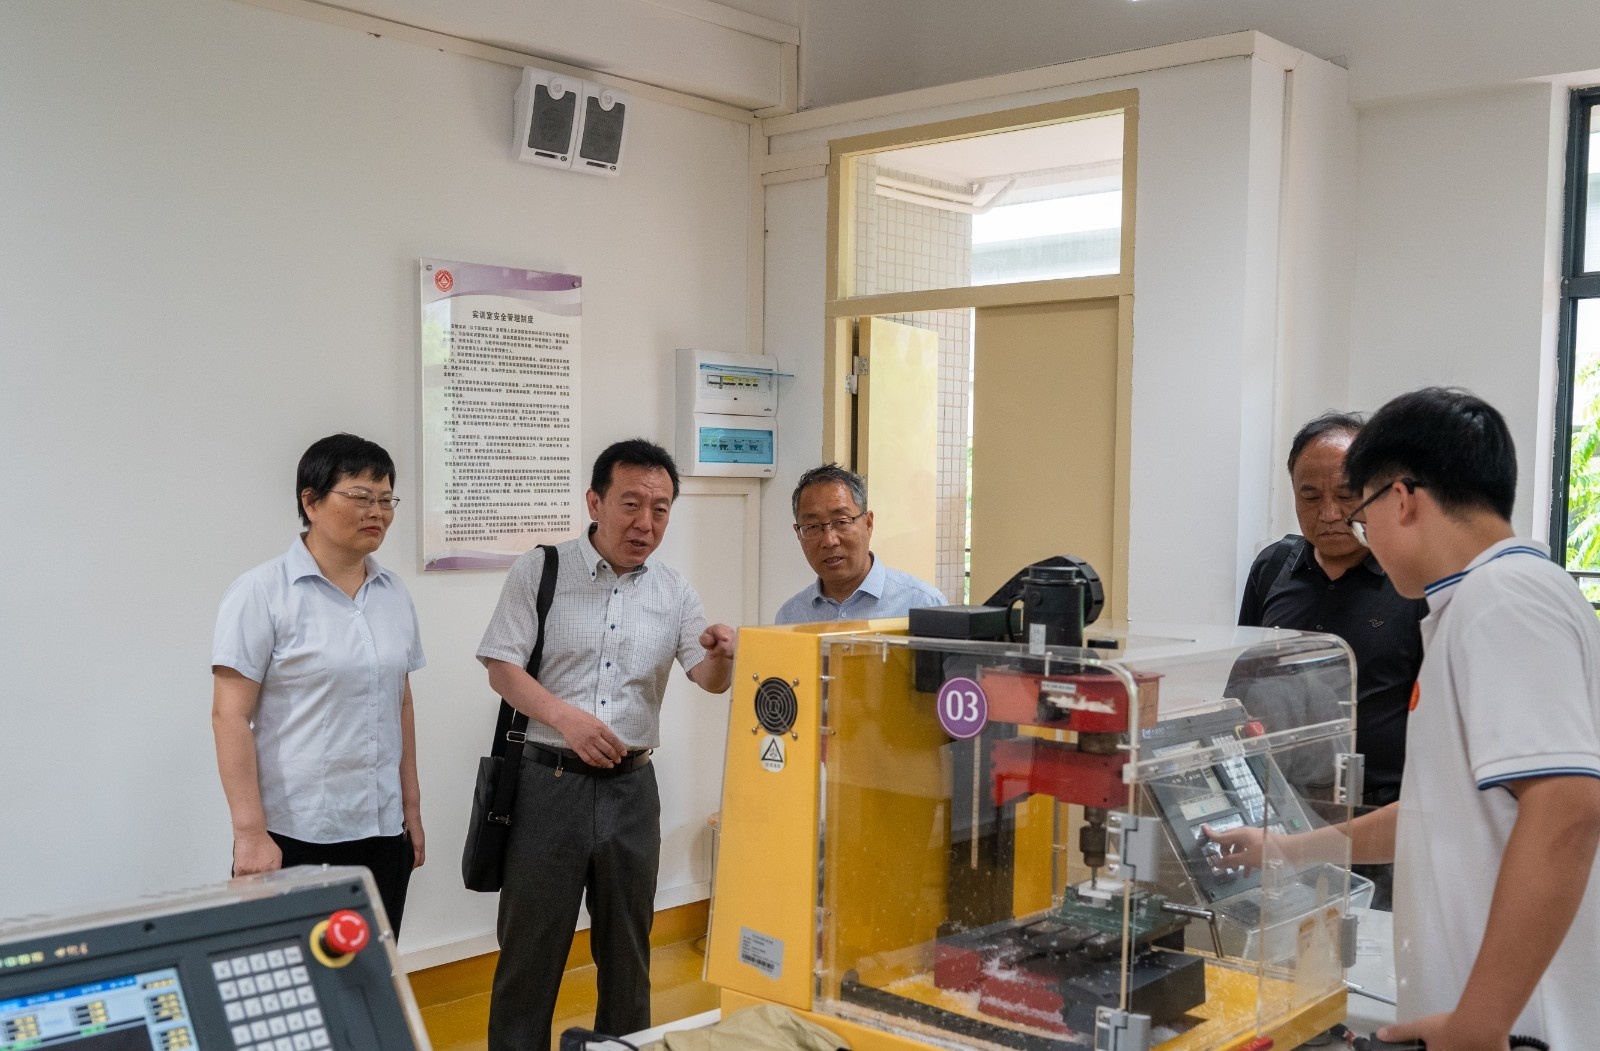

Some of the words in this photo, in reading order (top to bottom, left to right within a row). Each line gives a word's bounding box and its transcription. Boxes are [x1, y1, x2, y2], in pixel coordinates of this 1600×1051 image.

[472, 310, 534, 324] 实训室安全管理制度
[946, 690, 979, 722] 03
